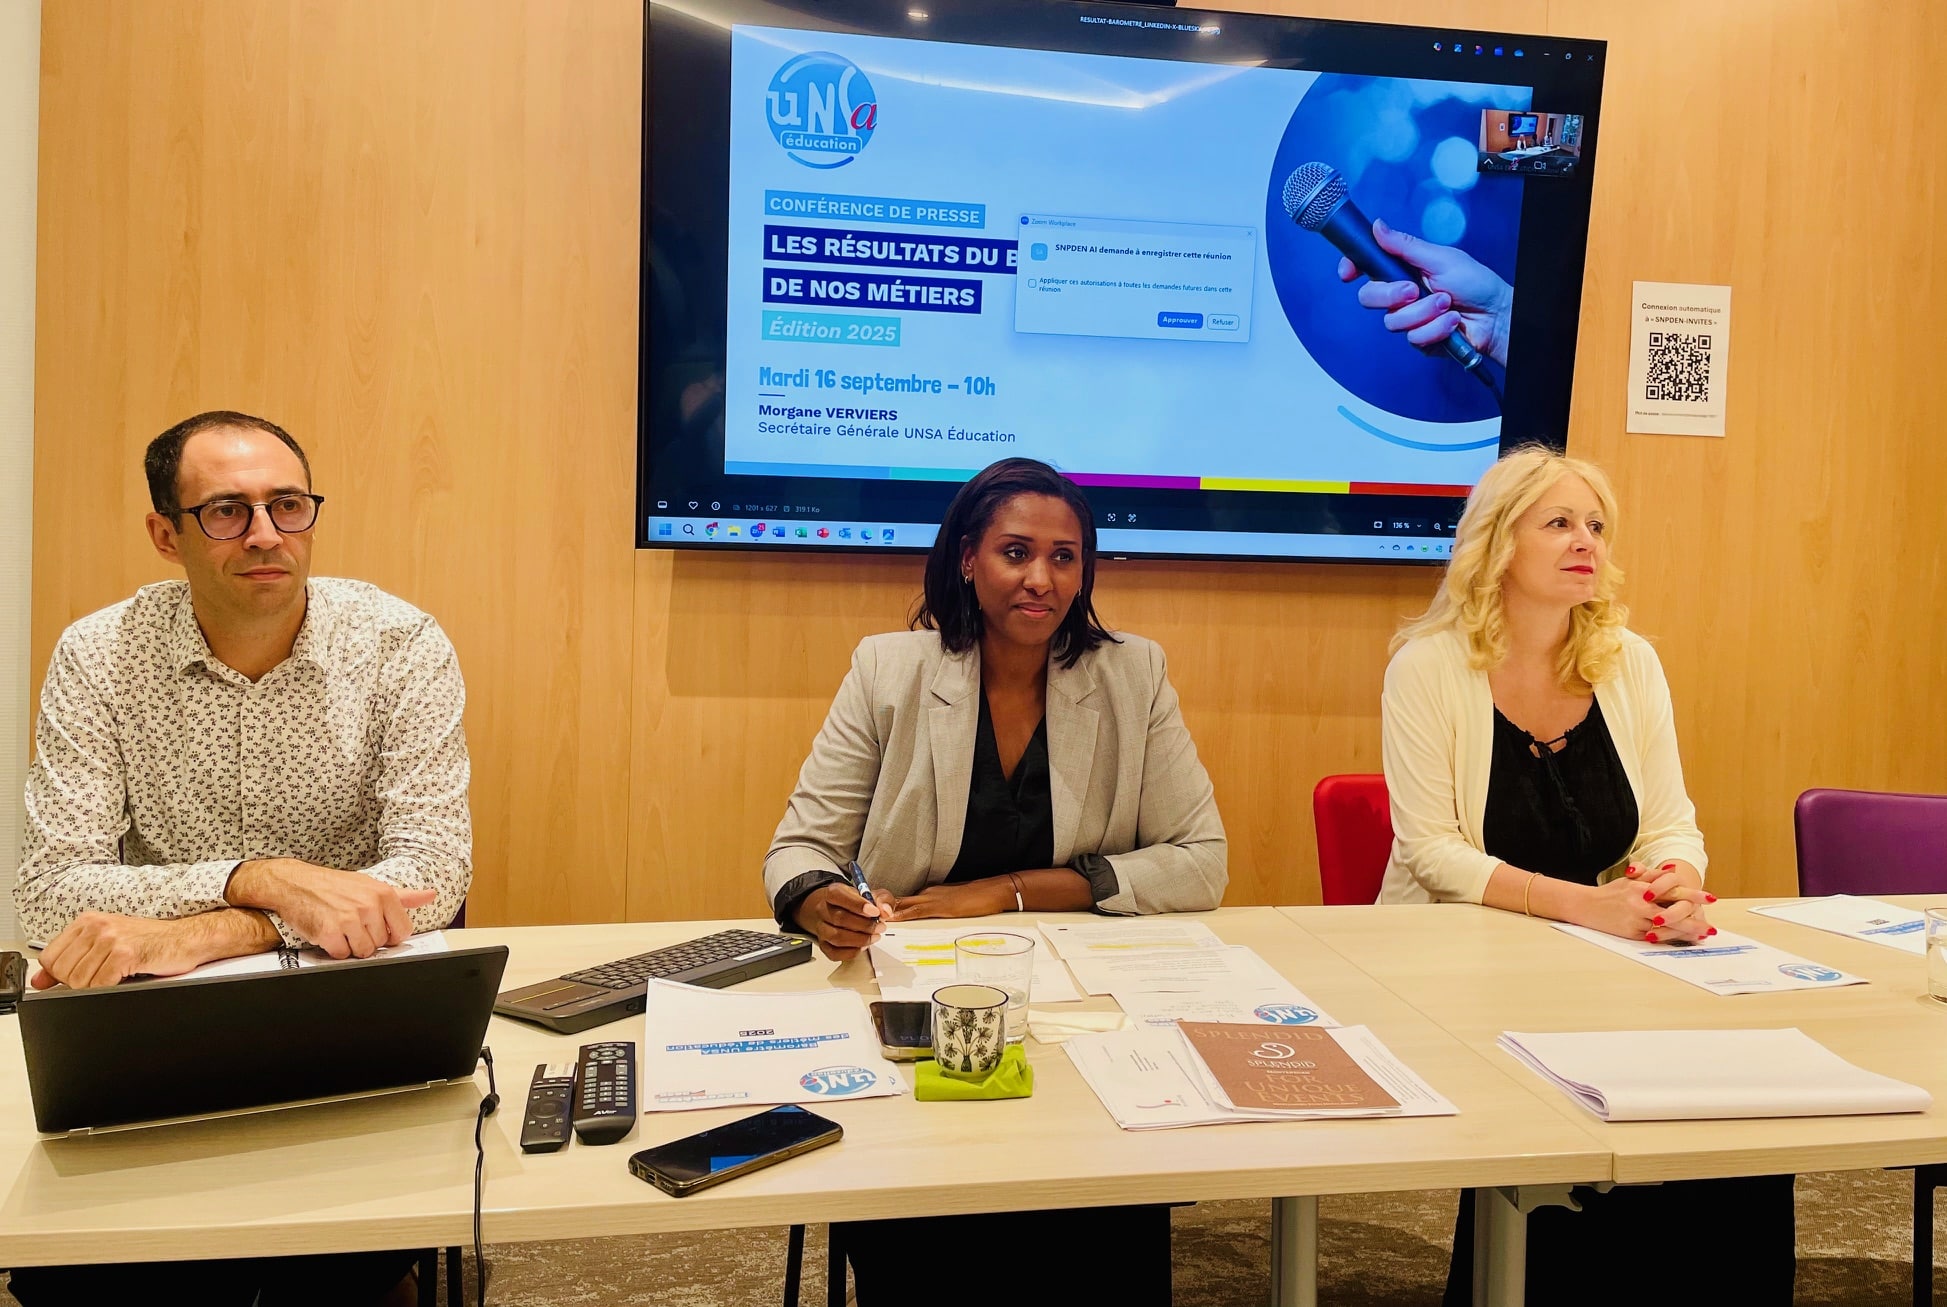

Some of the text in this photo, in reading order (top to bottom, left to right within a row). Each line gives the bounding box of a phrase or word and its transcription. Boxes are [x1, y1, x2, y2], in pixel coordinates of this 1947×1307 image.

[786, 134, 857, 151] éducation
[769, 197, 980, 224] CONFÉRENCE DE PRESSE
[771, 234, 818, 255] LES
[824, 234, 960, 264] RÉSULTATS
[965, 246, 999, 267] DU
[1055, 243, 1088, 253] SNPDEN
[1099, 246, 1134, 255] demande
[1135, 247, 1140, 255] à
[1141, 248, 1182, 259] enregistrer
[1183, 250, 1202, 259] cette
[1202, 251, 1232, 261] réunion
[770, 277, 975, 307] DE NOS MÉTIERS
[1039, 277, 1068, 286] Appliquer
[1080, 279, 1117, 287] autorisations
[1123, 280, 1141, 288] toutes
[1142, 281, 1151, 289] les
[1151, 282, 1182, 290] demandes
[1182, 283, 1202, 291] futures
[1203, 284, 1218, 292] dans
[1641, 302, 1721, 314] Connexion automatique
[768, 316, 897, 342] Édition 2025
[1162, 315, 1235, 326] Approuver Refuser
[759, 366, 810, 389] Mardi
[814, 369, 837, 389] 16
[840, 373, 942, 395] septembre
[963, 376, 996, 396] 10h
[758, 404, 899, 422] Morgane VERVIERS
[758, 421, 1016, 443] Secrétaire Générale UNSA Éducation
[1194, 1029, 1324, 1041] SPLENDID
[1247, 1060, 1317, 1069] SPLENDID
[1244, 1080, 1363, 1094] UNIQUE
[1265, 1074, 1323, 1084] FOR
[1256, 1092, 1365, 1103] EVENTS
